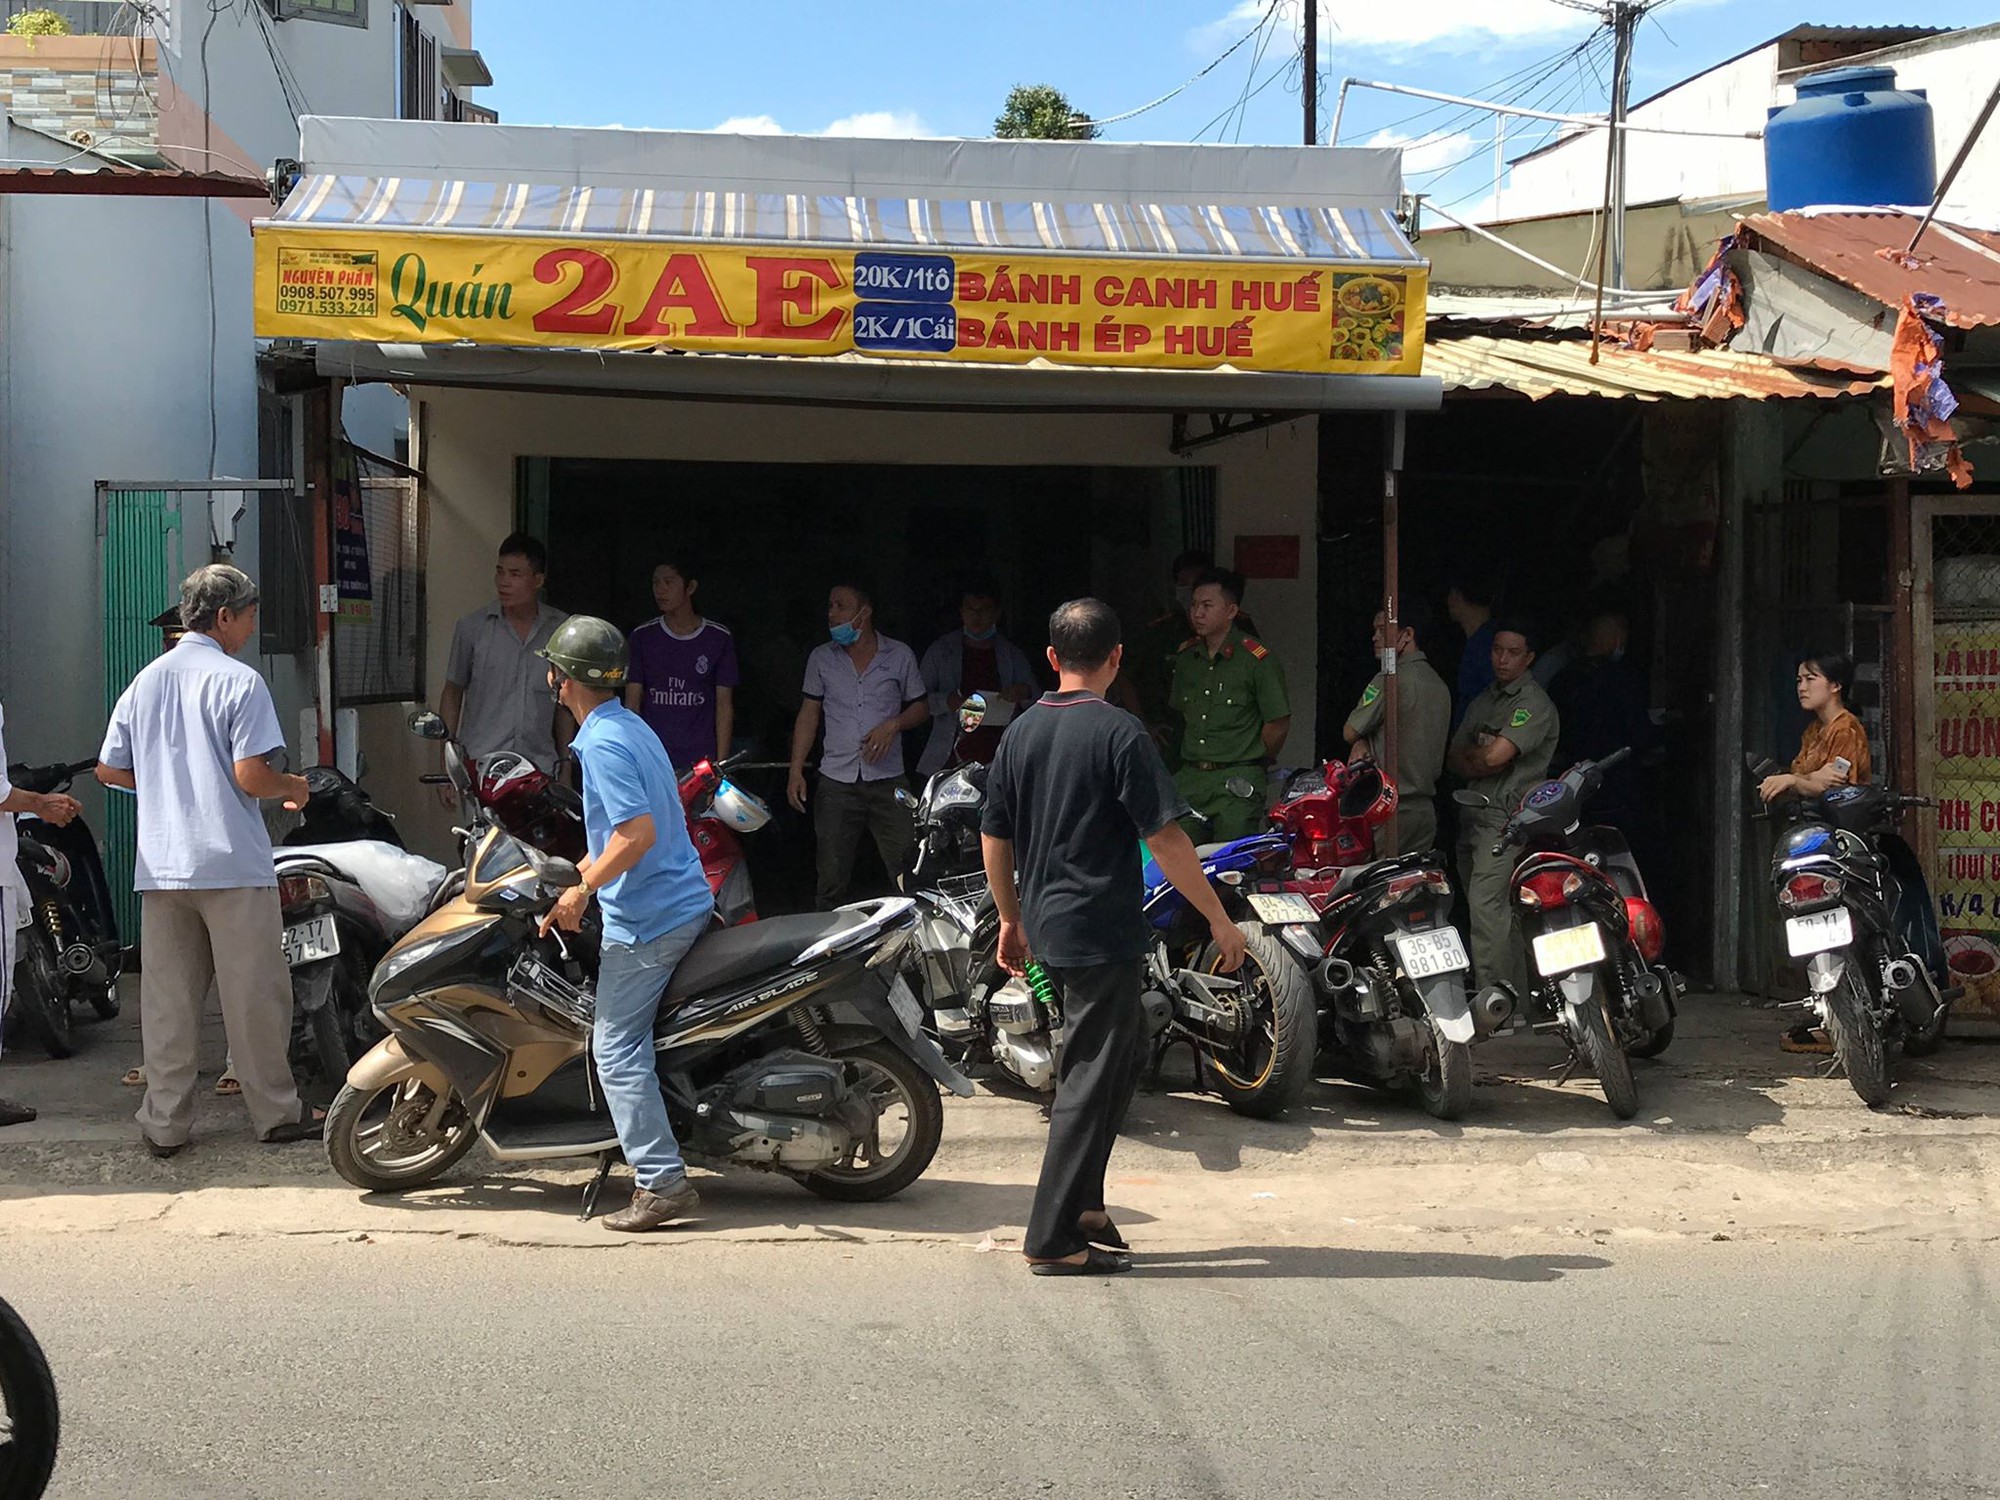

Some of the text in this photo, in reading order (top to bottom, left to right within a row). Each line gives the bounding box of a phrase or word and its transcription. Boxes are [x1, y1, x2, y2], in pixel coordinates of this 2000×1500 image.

[854, 264, 950, 291] 20K/1tô
[958, 265, 1323, 312] BÁNH CANH HUẾ
[279, 285, 375, 301] 0908.507.995
[390, 247, 850, 341] Quán 2AE
[279, 299, 375, 315] 0971.533.244
[854, 315, 955, 341] 2K/1Cái
[957, 312, 1256, 357] BÁNH ÉP HUẾ
[649, 687, 705, 716] Emirates
[668, 677, 686, 700] Fly
[1407, 932, 1452, 956] 36-B5
[1409, 949, 1464, 976] 981.80
[724, 971, 819, 1016] AIR BLADE
